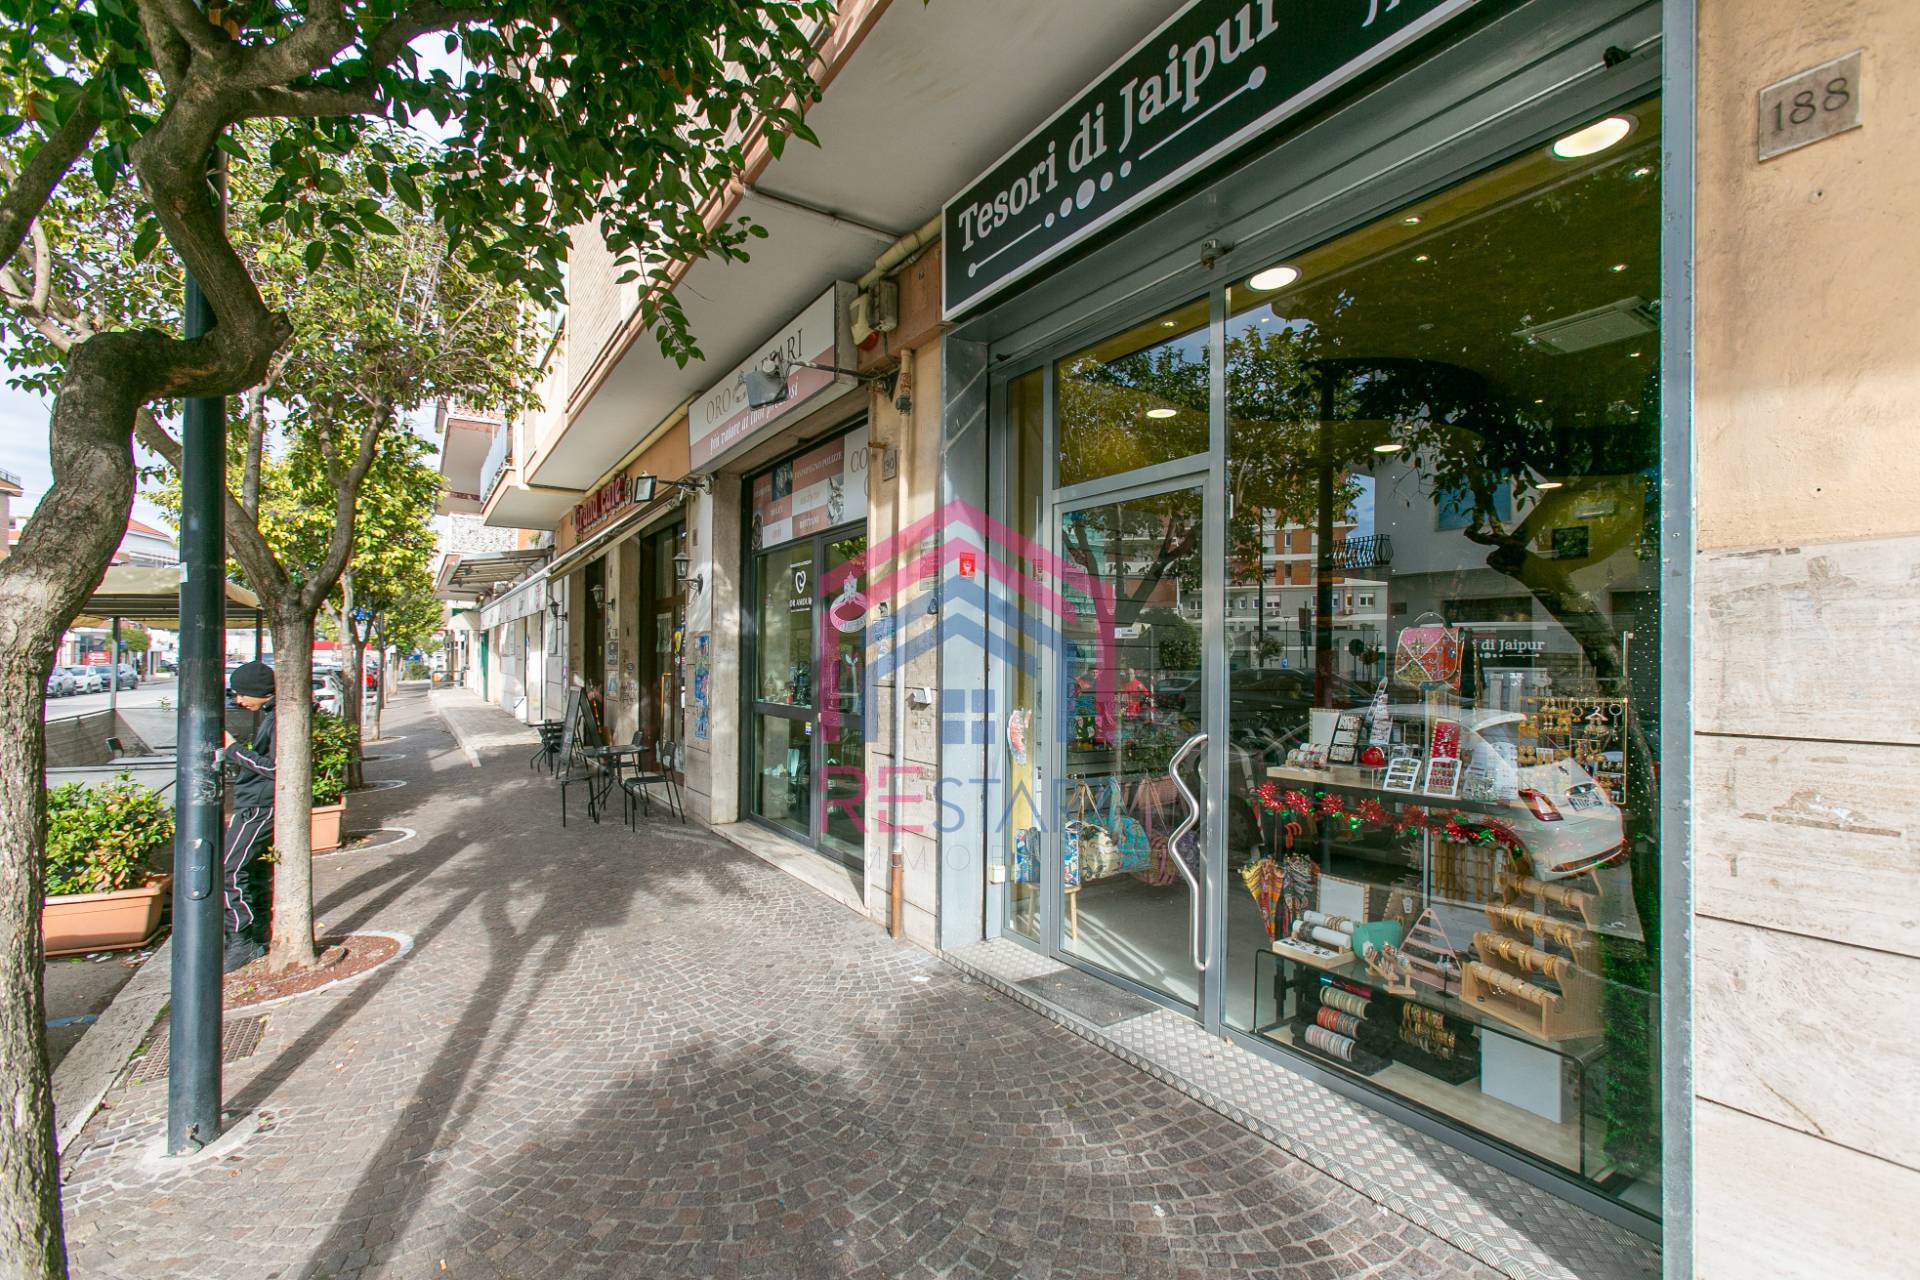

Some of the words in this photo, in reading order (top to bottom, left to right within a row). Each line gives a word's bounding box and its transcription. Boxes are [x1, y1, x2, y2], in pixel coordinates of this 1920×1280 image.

[1774, 77, 1850, 133] 188
[958, 140, 1058, 252] Tesori
[1067, 103, 1107, 174] di
[705, 387, 732, 425] ORO
[1480, 639, 1496, 651] di
[1498, 639, 1546, 654] Jaipur
